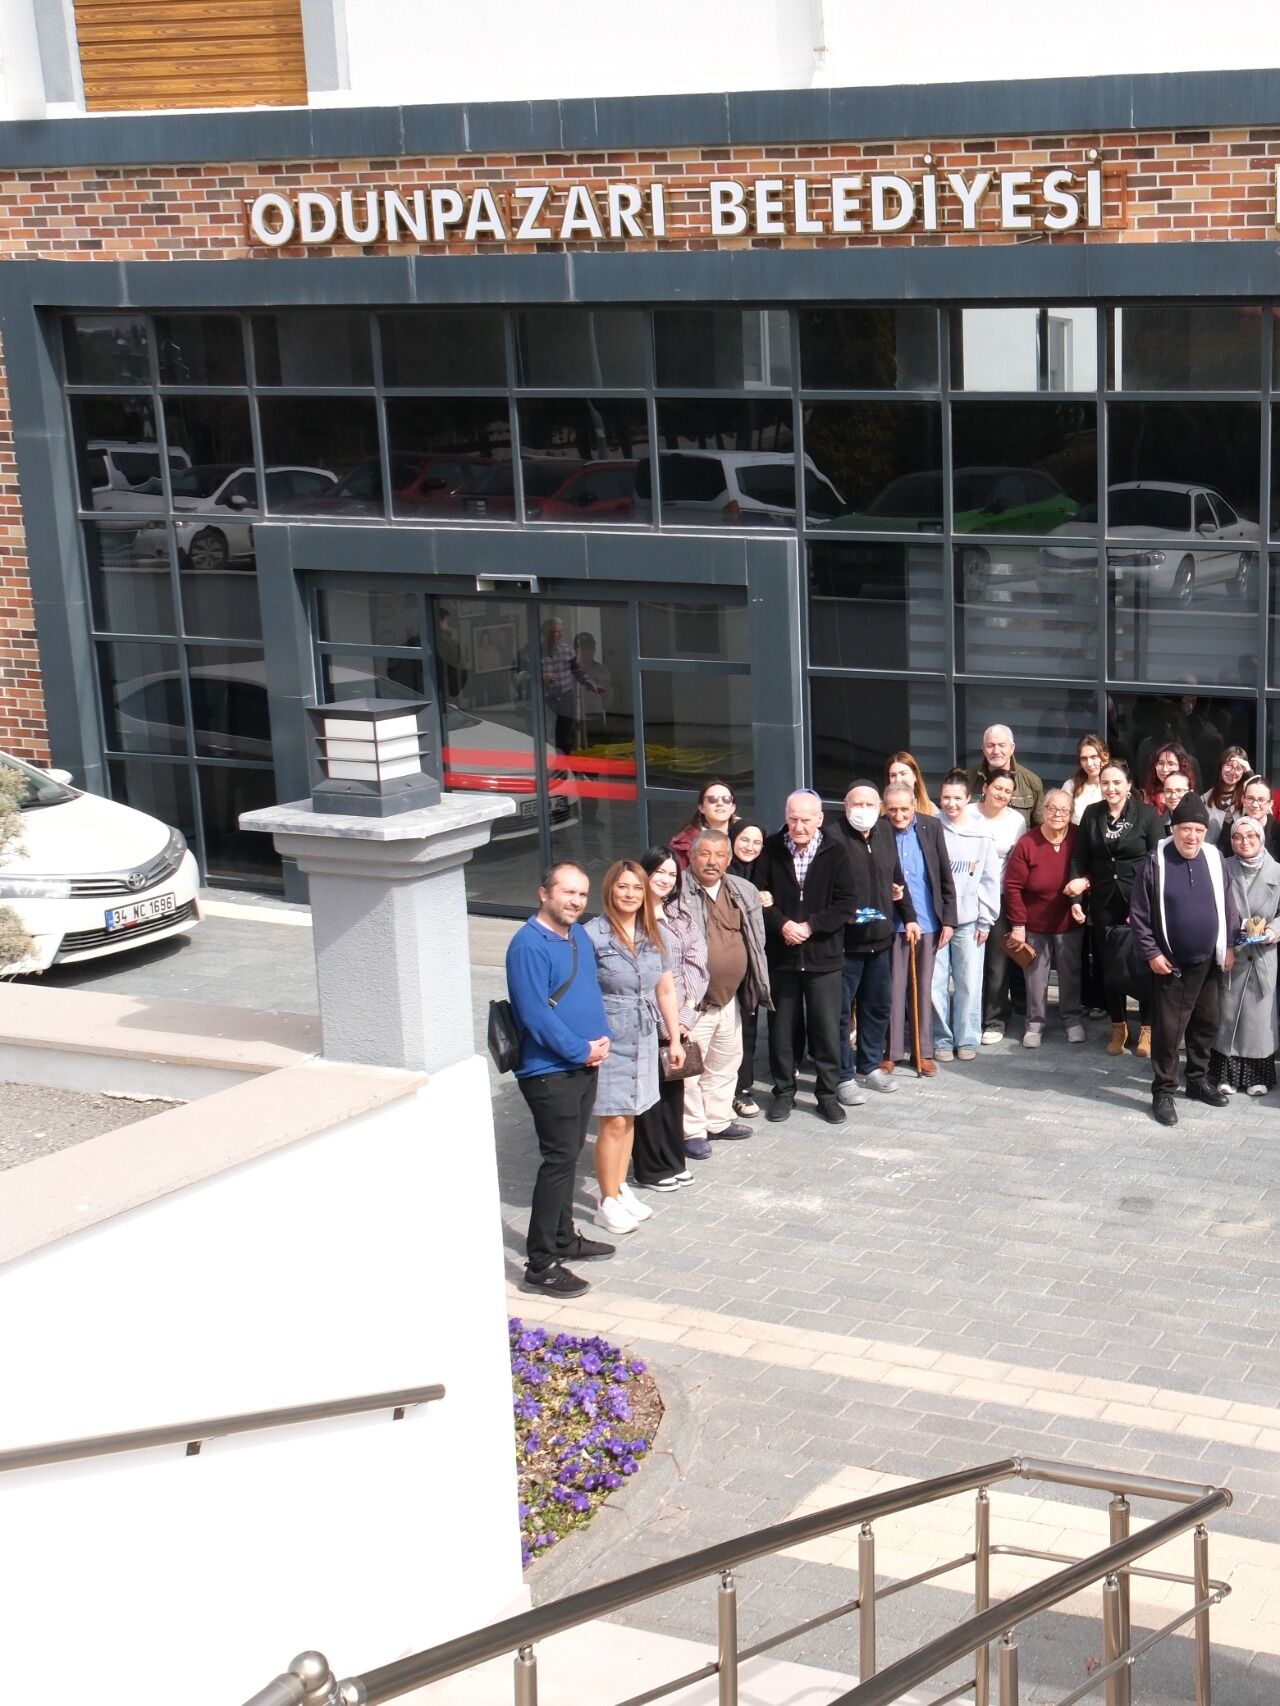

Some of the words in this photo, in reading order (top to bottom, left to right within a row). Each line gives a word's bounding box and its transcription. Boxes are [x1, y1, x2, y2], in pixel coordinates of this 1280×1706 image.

[250, 183, 667, 246] ODUNPAZARI
[709, 149, 1103, 236] BELEDİYESİ
[114, 909, 127, 924] 34
[133, 904, 146, 919] NC
[149, 896, 173, 914] 1696
